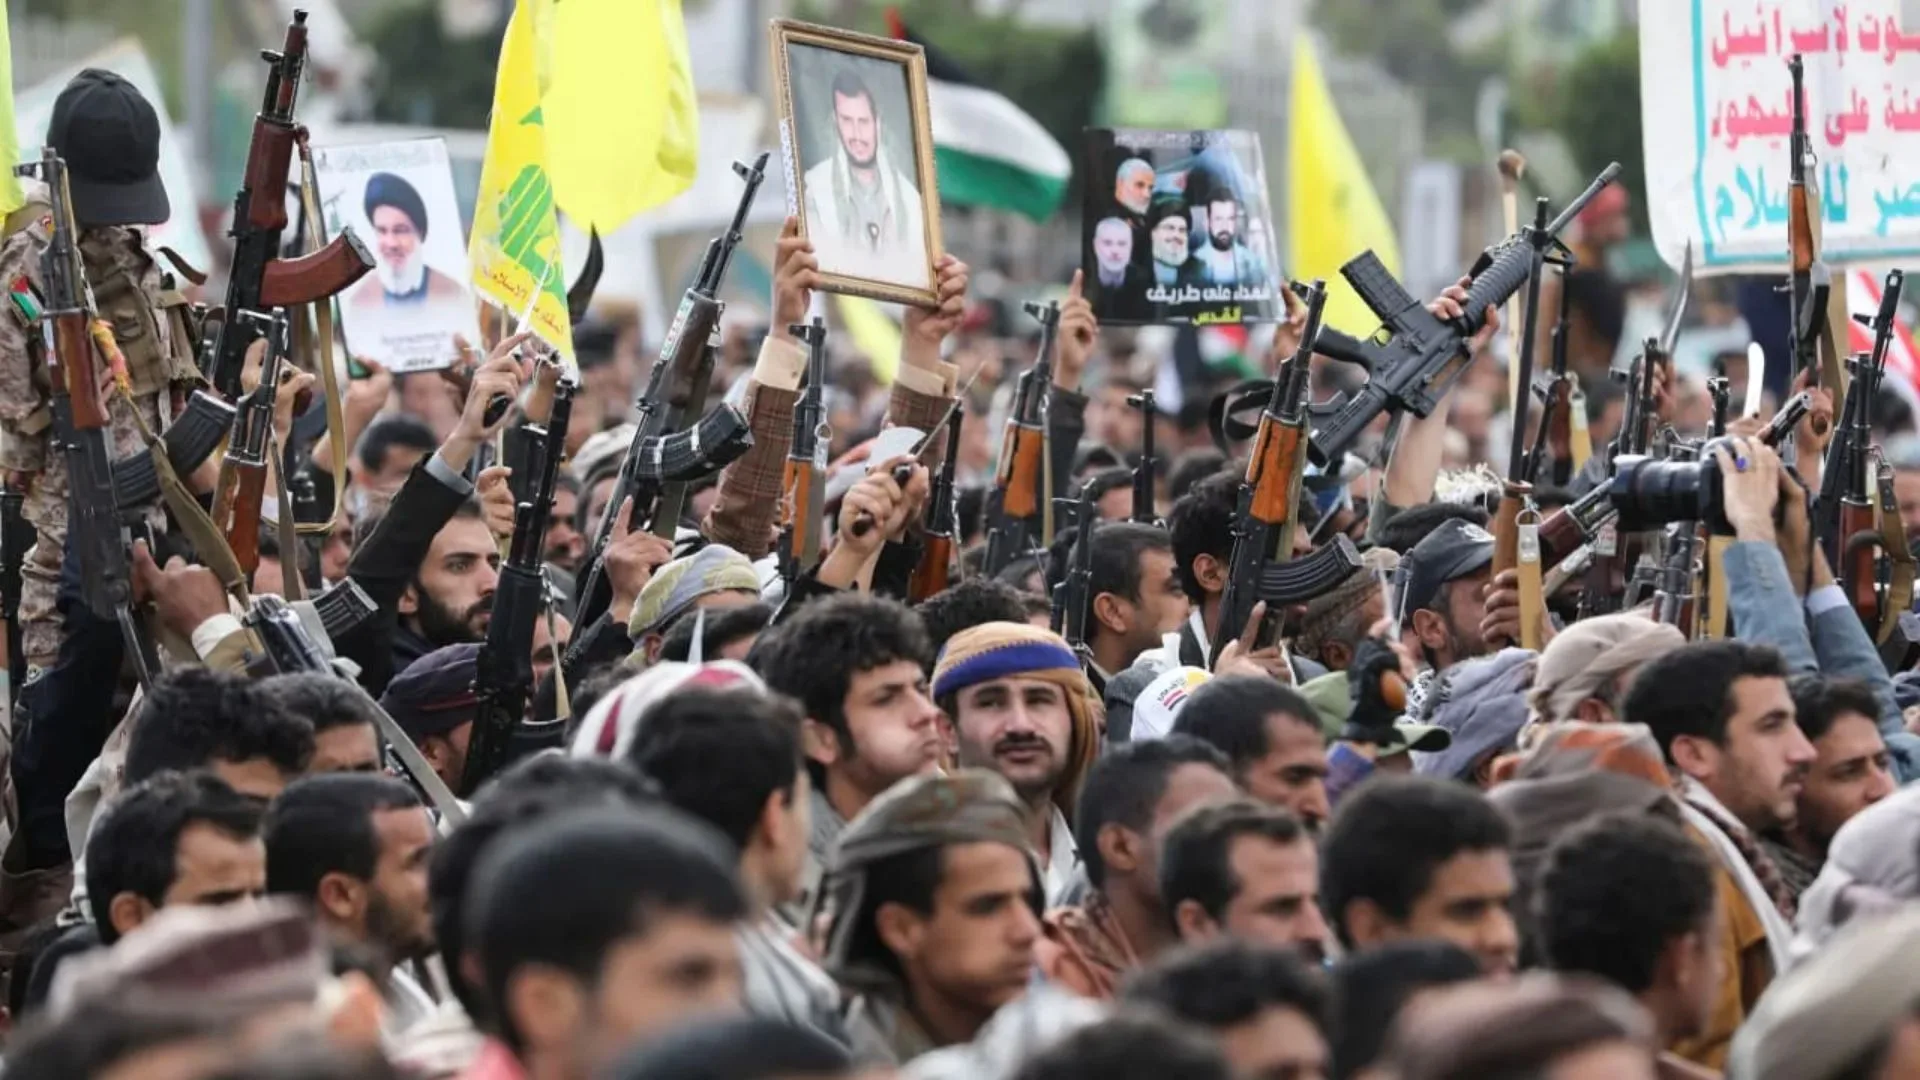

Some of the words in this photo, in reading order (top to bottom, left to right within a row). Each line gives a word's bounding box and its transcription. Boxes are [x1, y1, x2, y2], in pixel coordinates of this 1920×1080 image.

[1712, 88, 1809, 149] اليهود
[1825, 87, 1870, 147] على
[1203, 284, 1231, 301] على
